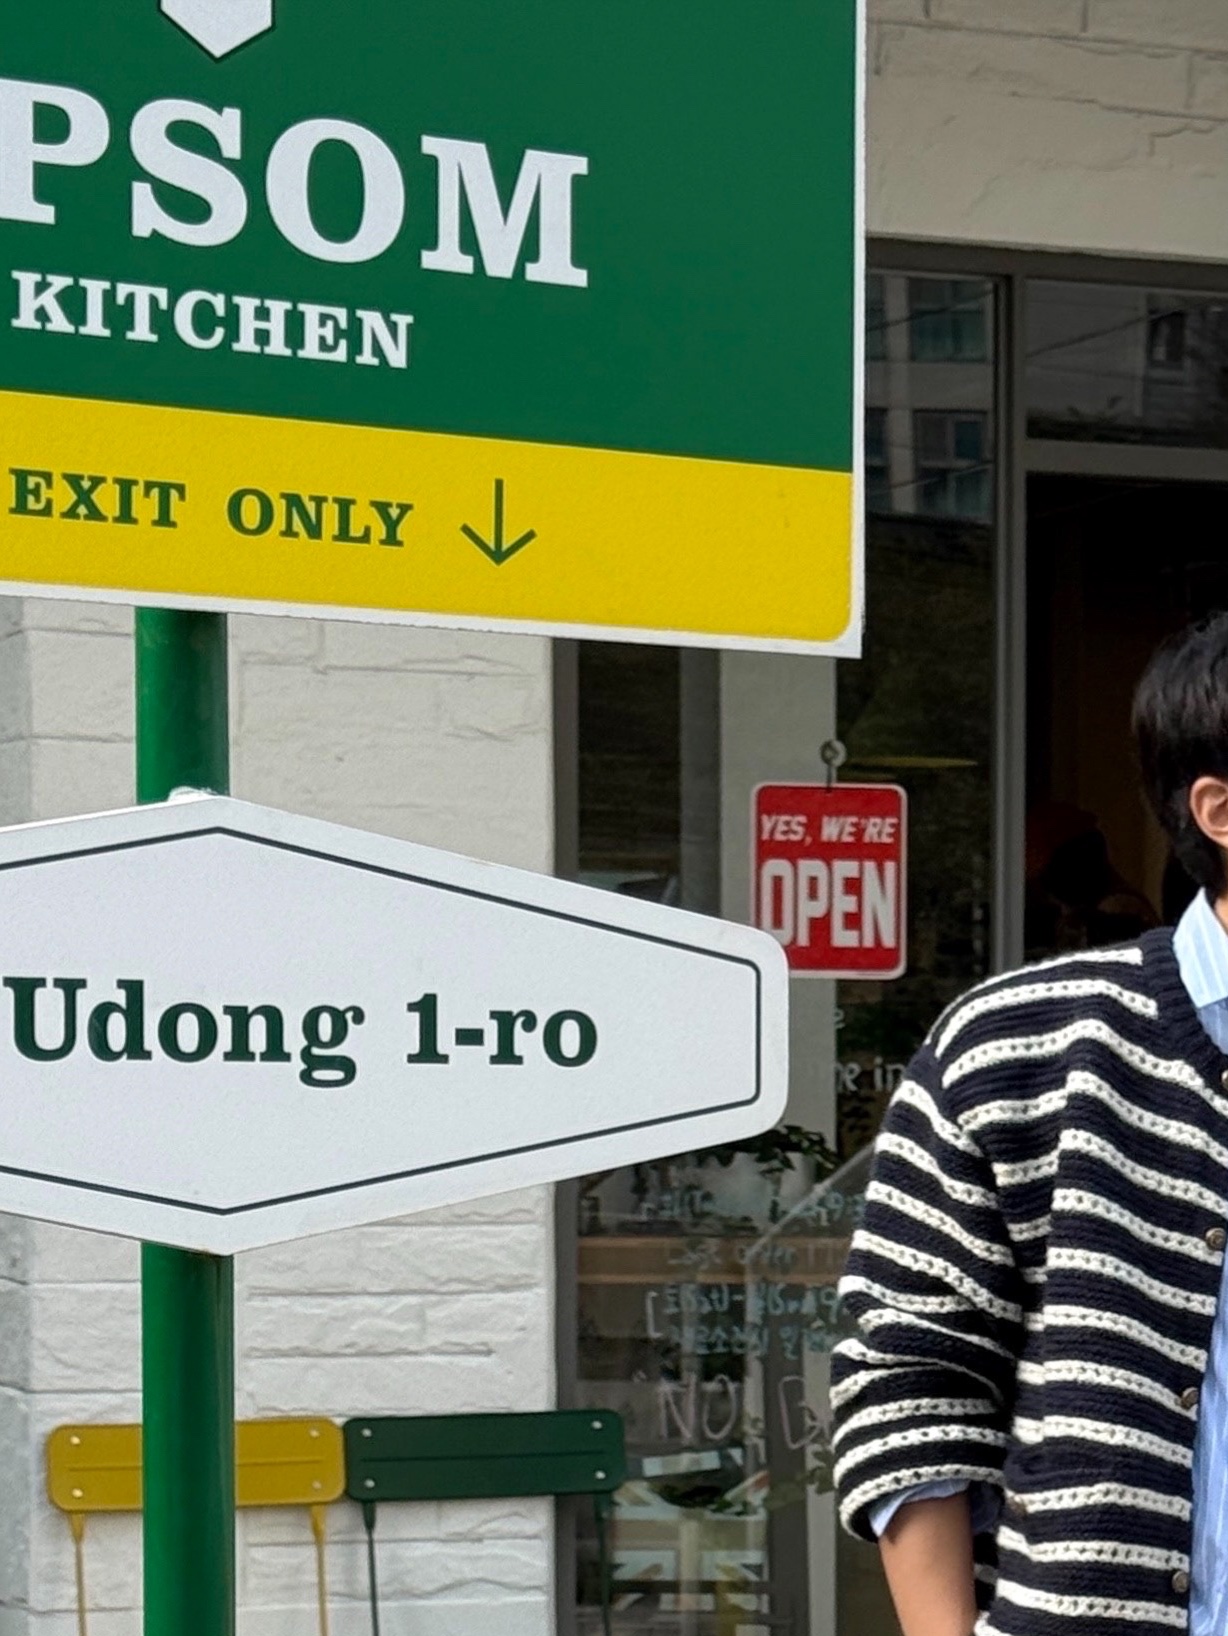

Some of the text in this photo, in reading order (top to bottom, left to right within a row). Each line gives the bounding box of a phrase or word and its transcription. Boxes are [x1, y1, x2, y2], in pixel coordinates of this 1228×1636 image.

[11, 270, 413, 369] KITCHEN
[9, 468, 413, 548] EXIT ONLY
[760, 813, 899, 847] YES, WE'RE
[760, 857, 897, 949] OPEN
[2, 975, 599, 1089] Udong 1-ro
